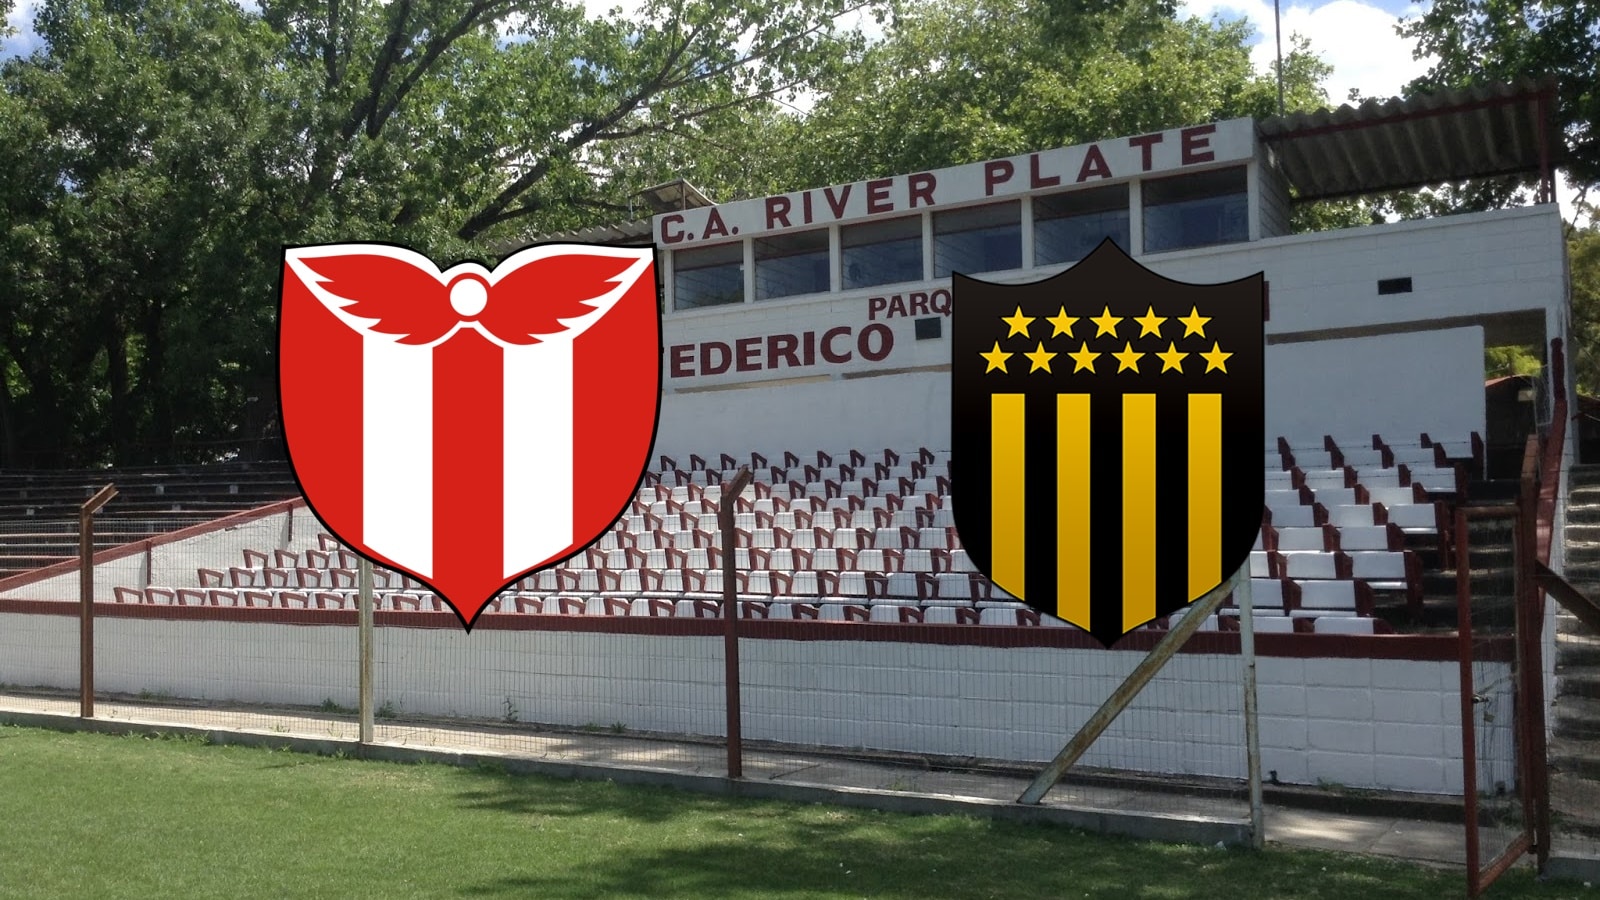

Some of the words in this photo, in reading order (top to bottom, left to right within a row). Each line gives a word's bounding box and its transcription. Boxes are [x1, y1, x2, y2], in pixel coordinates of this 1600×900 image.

[661, 208, 739, 244] C.A.
[765, 172, 937, 230] RIVER
[985, 124, 1216, 196] PLATE
[661, 323, 894, 378] EDERICO
